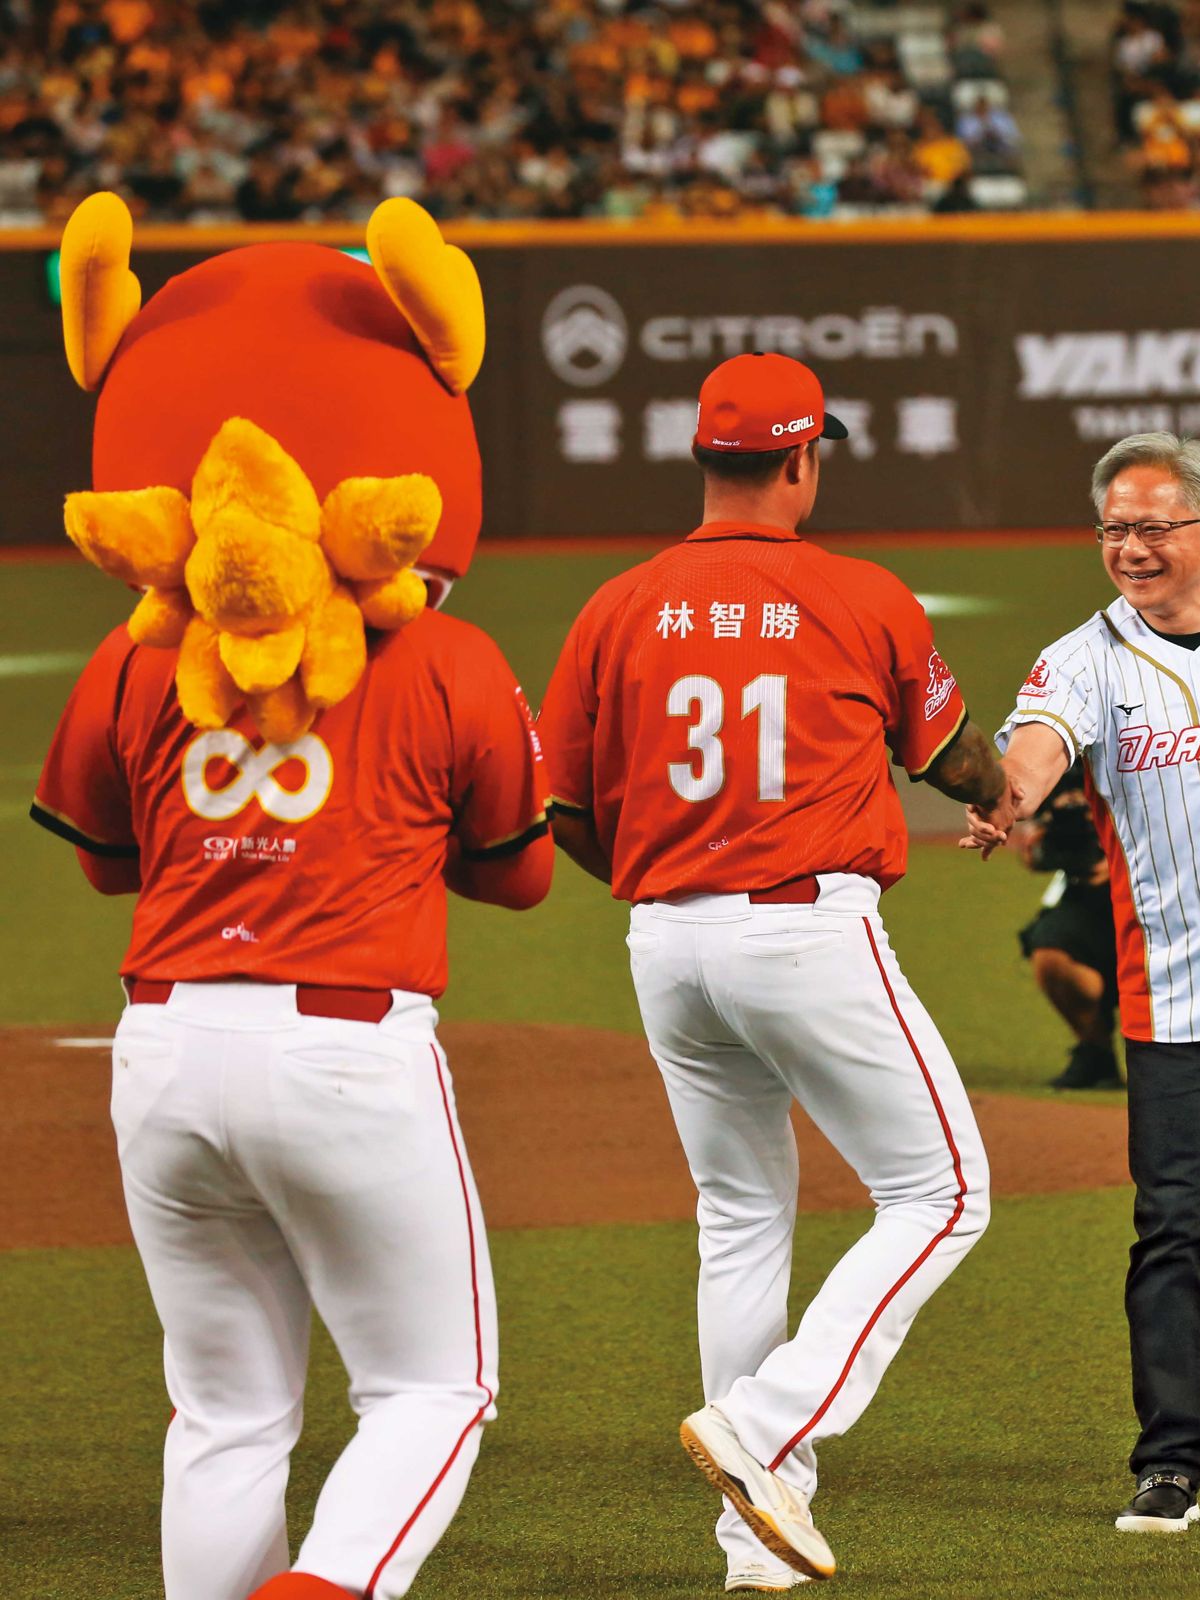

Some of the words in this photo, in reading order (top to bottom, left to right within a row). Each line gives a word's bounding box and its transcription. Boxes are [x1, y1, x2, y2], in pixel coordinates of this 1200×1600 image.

[772, 415, 814, 436] O-GRILL
[656, 601, 799, 639] 林智勝
[666, 673, 788, 802] 31
